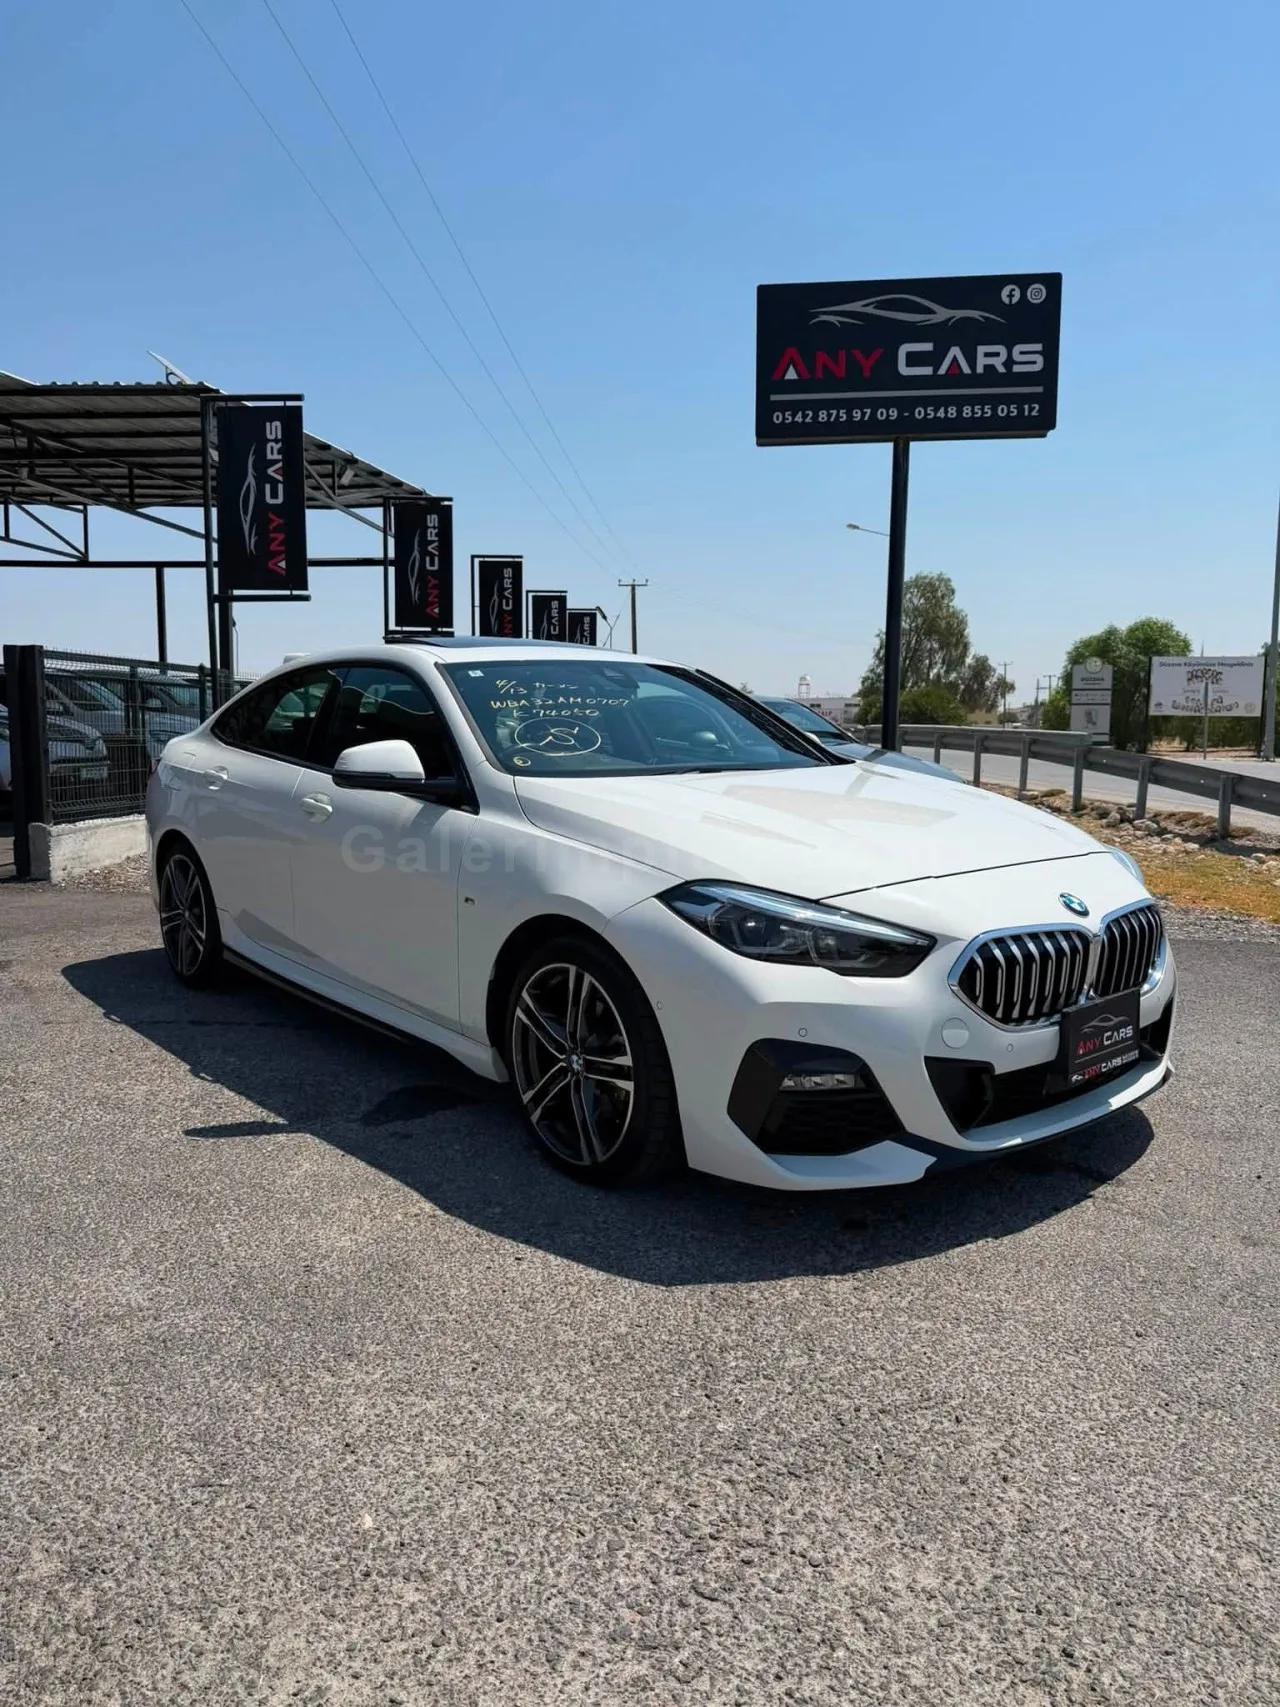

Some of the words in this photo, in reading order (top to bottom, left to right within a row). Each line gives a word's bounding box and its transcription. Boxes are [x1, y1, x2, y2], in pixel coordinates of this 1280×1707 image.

[771, 347, 884, 380] ANY
[898, 343, 1044, 376] CARS
[773, 411, 813, 424] 0542
[818, 409, 847, 422] 875
[852, 408, 871, 421] 97
[876, 407, 898, 420] 09
[914, 406, 957, 419] 0548
[962, 405, 992, 418] 855
[997, 404, 1018, 417] 05
[1024, 403, 1040, 416] 12
[265, 421, 283, 504] CARS
[268, 512, 287, 576] ANY
[425, 514, 439, 571] CARS
[425, 576, 440, 619] ANY
[502, 567, 513, 610] CARS
[550, 600, 559, 635] CARS
[1075, 1037, 1101, 1055] ANY
[1103, 1025, 1133, 1046] CARS
